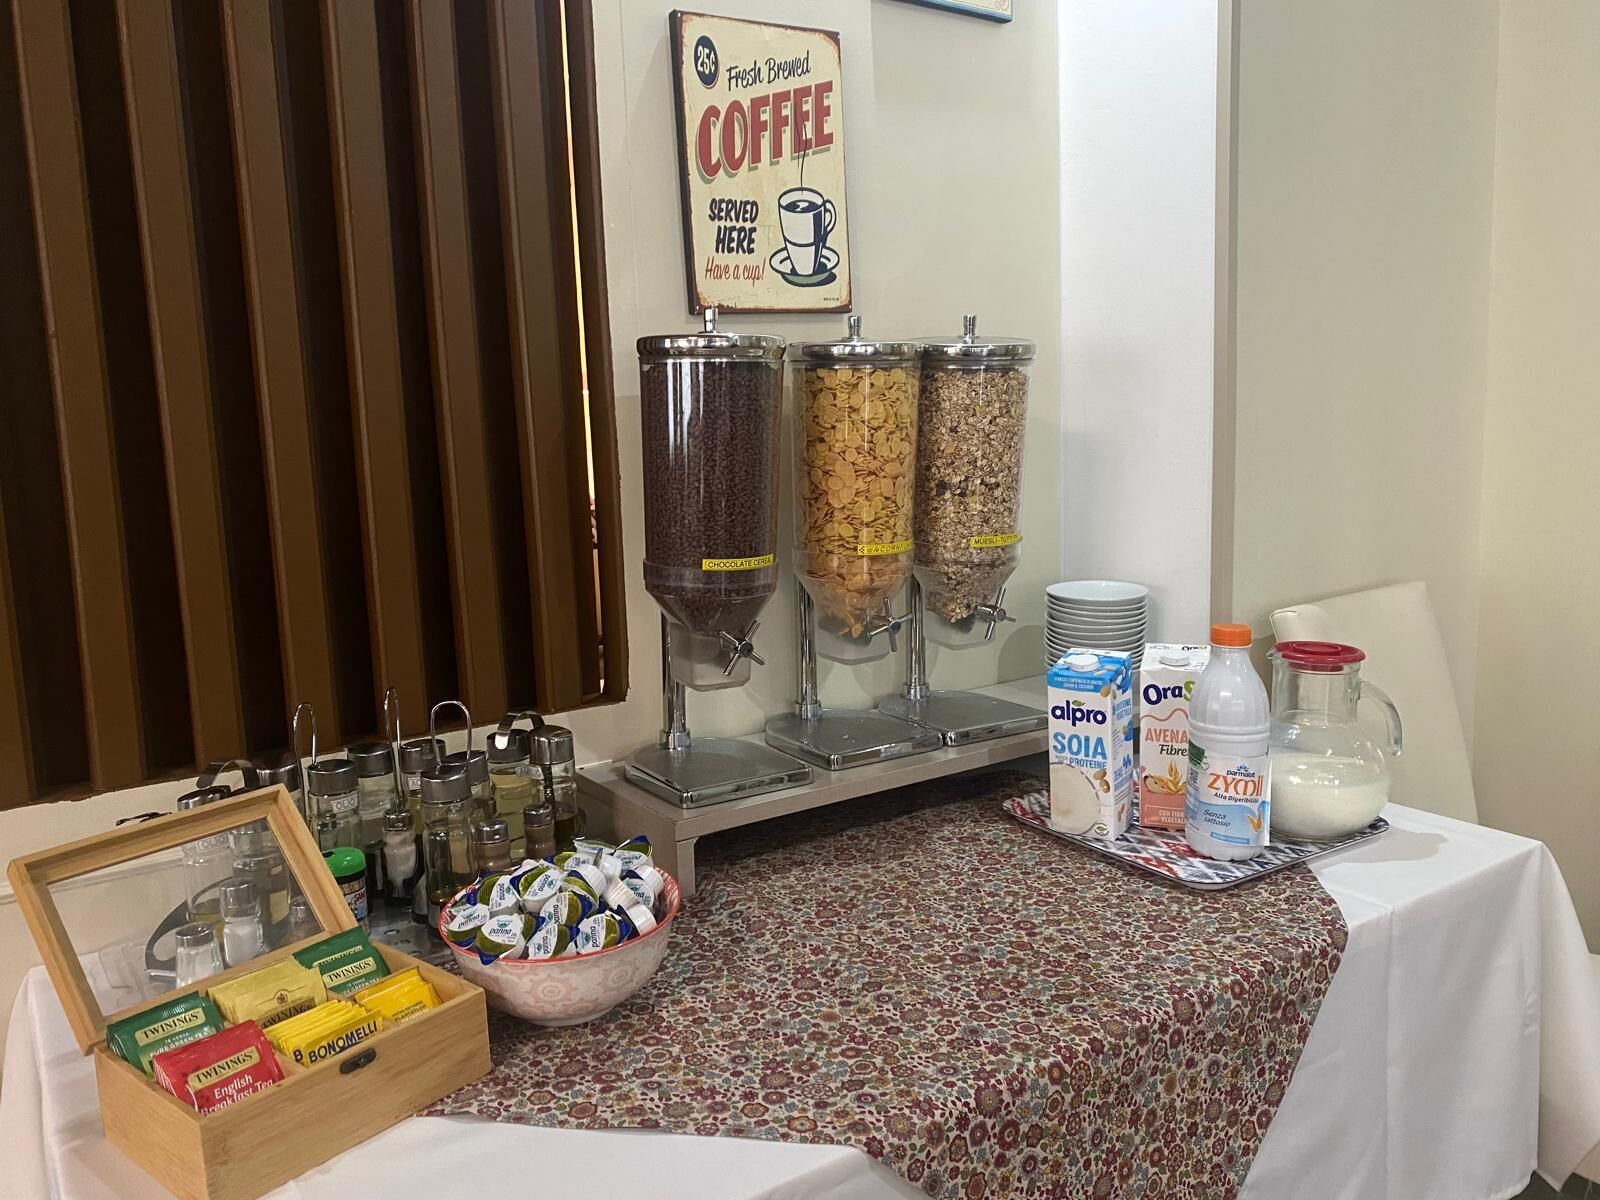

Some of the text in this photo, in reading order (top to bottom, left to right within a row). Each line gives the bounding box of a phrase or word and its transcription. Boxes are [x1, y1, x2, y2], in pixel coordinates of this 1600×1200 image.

[726, 49, 811, 92] Fresh Brewed
[695, 80, 833, 183] COFFEE
[708, 198, 759, 223] SERVED
[715, 225, 757, 254] HERE
[705, 256, 767, 287] Have a cup!
[708, 560, 751, 568] CHOCOLATE
[1051, 700, 1107, 727] alpro
[1053, 732, 1107, 760] SOIA
[1145, 728, 1188, 744] AVENA
[1159, 744, 1187, 757] Fibre
[1069, 757, 1107, 769] PROTEINE
[1214, 792, 1227, 800] Alta
[1204, 808, 1226, 819] Senza
[1204, 817, 1230, 827] lattosio
[458, 914, 480, 930] panna
[489, 928, 512, 936] panna
[543, 935, 551, 955] panna
[589, 926, 600, 948] panna
[327, 960, 371, 983] TWININGS
[142, 1011, 199, 1039] TWININGS
[170, 1036, 194, 1049] GREEN
[308, 1020, 378, 1064] BONOMELLI
[194, 1050, 253, 1083] TWININGS
[214, 1073, 253, 1099] English
[255, 1079, 273, 1092] Tea
